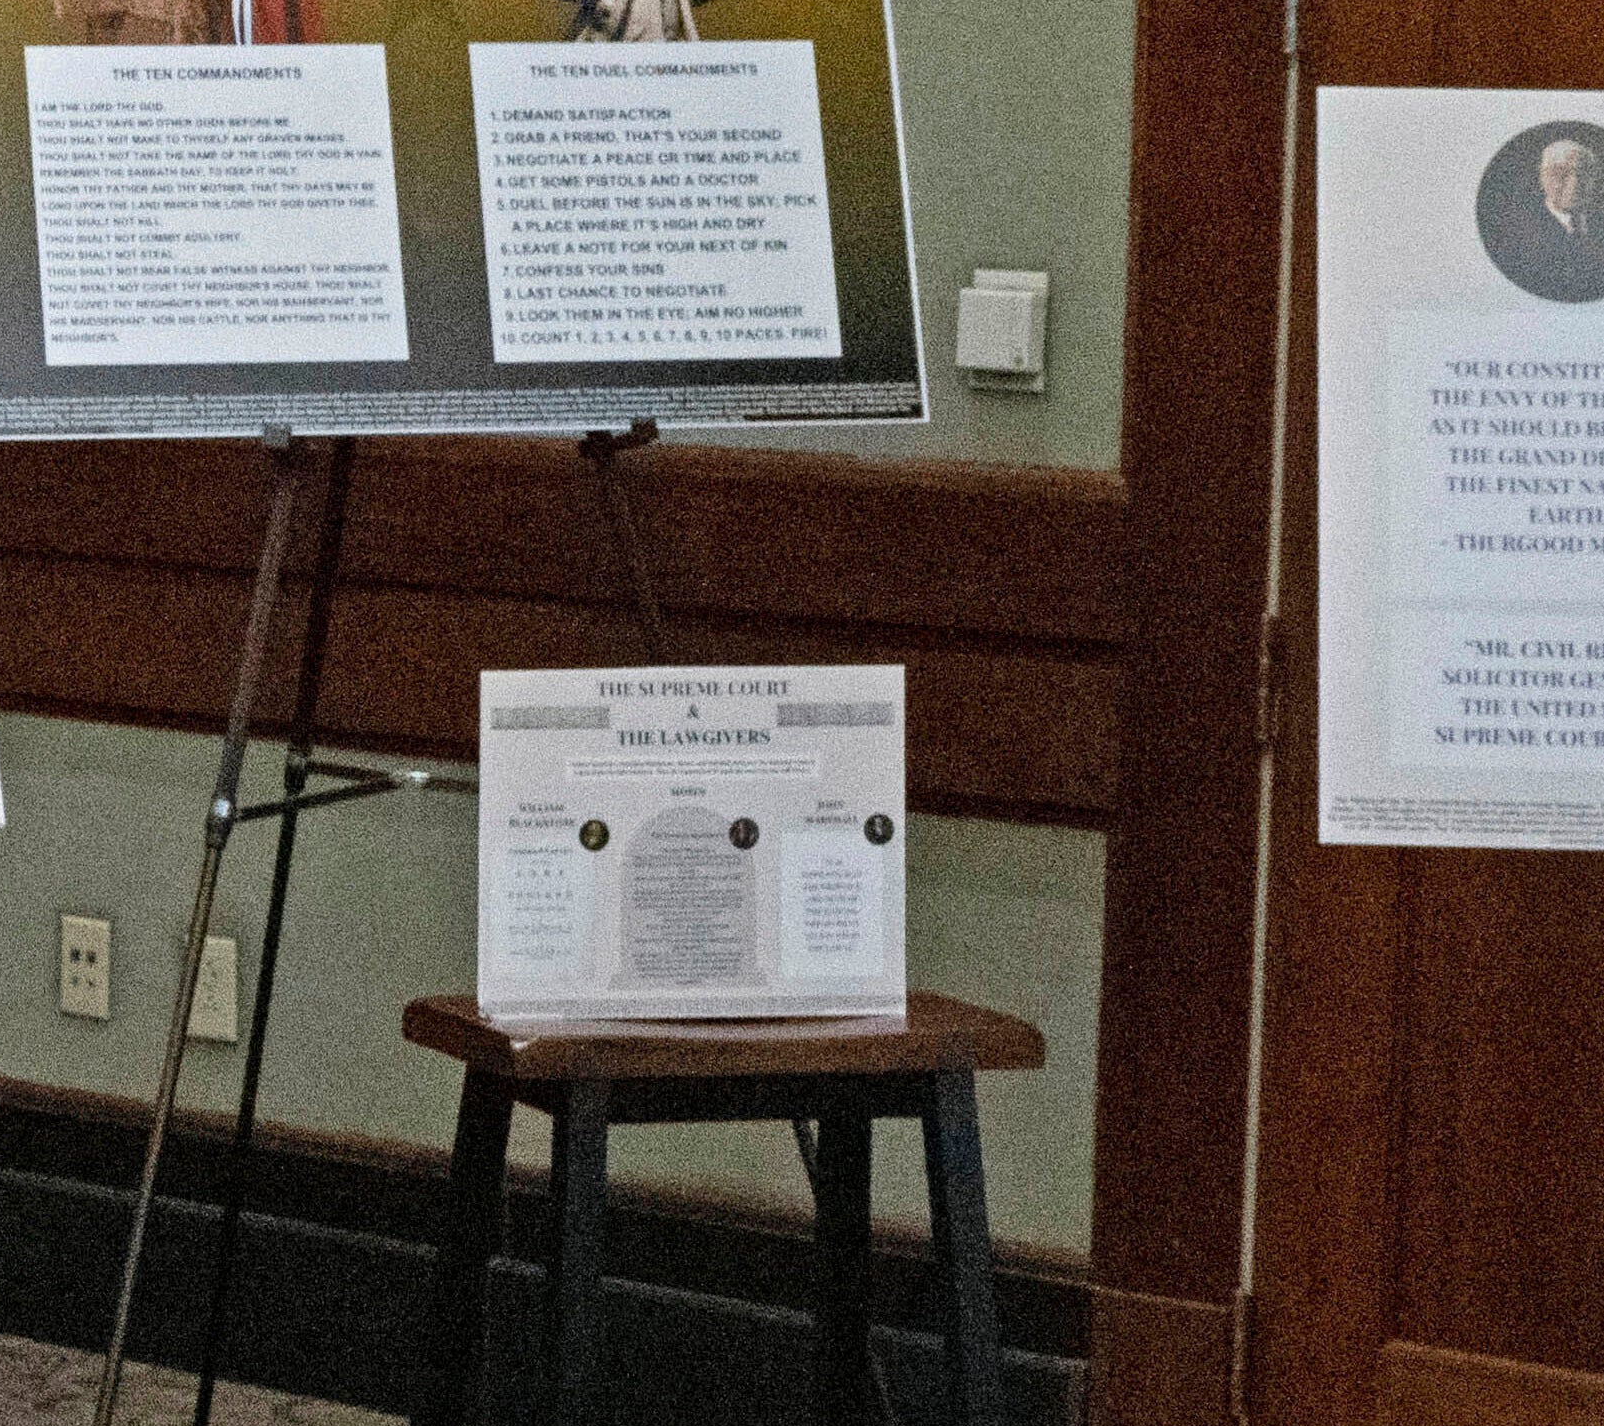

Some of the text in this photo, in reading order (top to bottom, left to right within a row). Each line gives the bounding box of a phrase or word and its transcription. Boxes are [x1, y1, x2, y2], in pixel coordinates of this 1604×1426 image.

[113, 67, 301, 79] THE TEN COMMANDMENTS
[530, 63, 757, 77] THE TEN DUEL COMMANDMENTS
[502, 109, 564, 121] DEMAND
[567, 107, 671, 121] SATISFACTION
[599, 680, 788, 696] THE SUPREME COURT
[618, 729, 770, 745] THE LAWGIVERS
